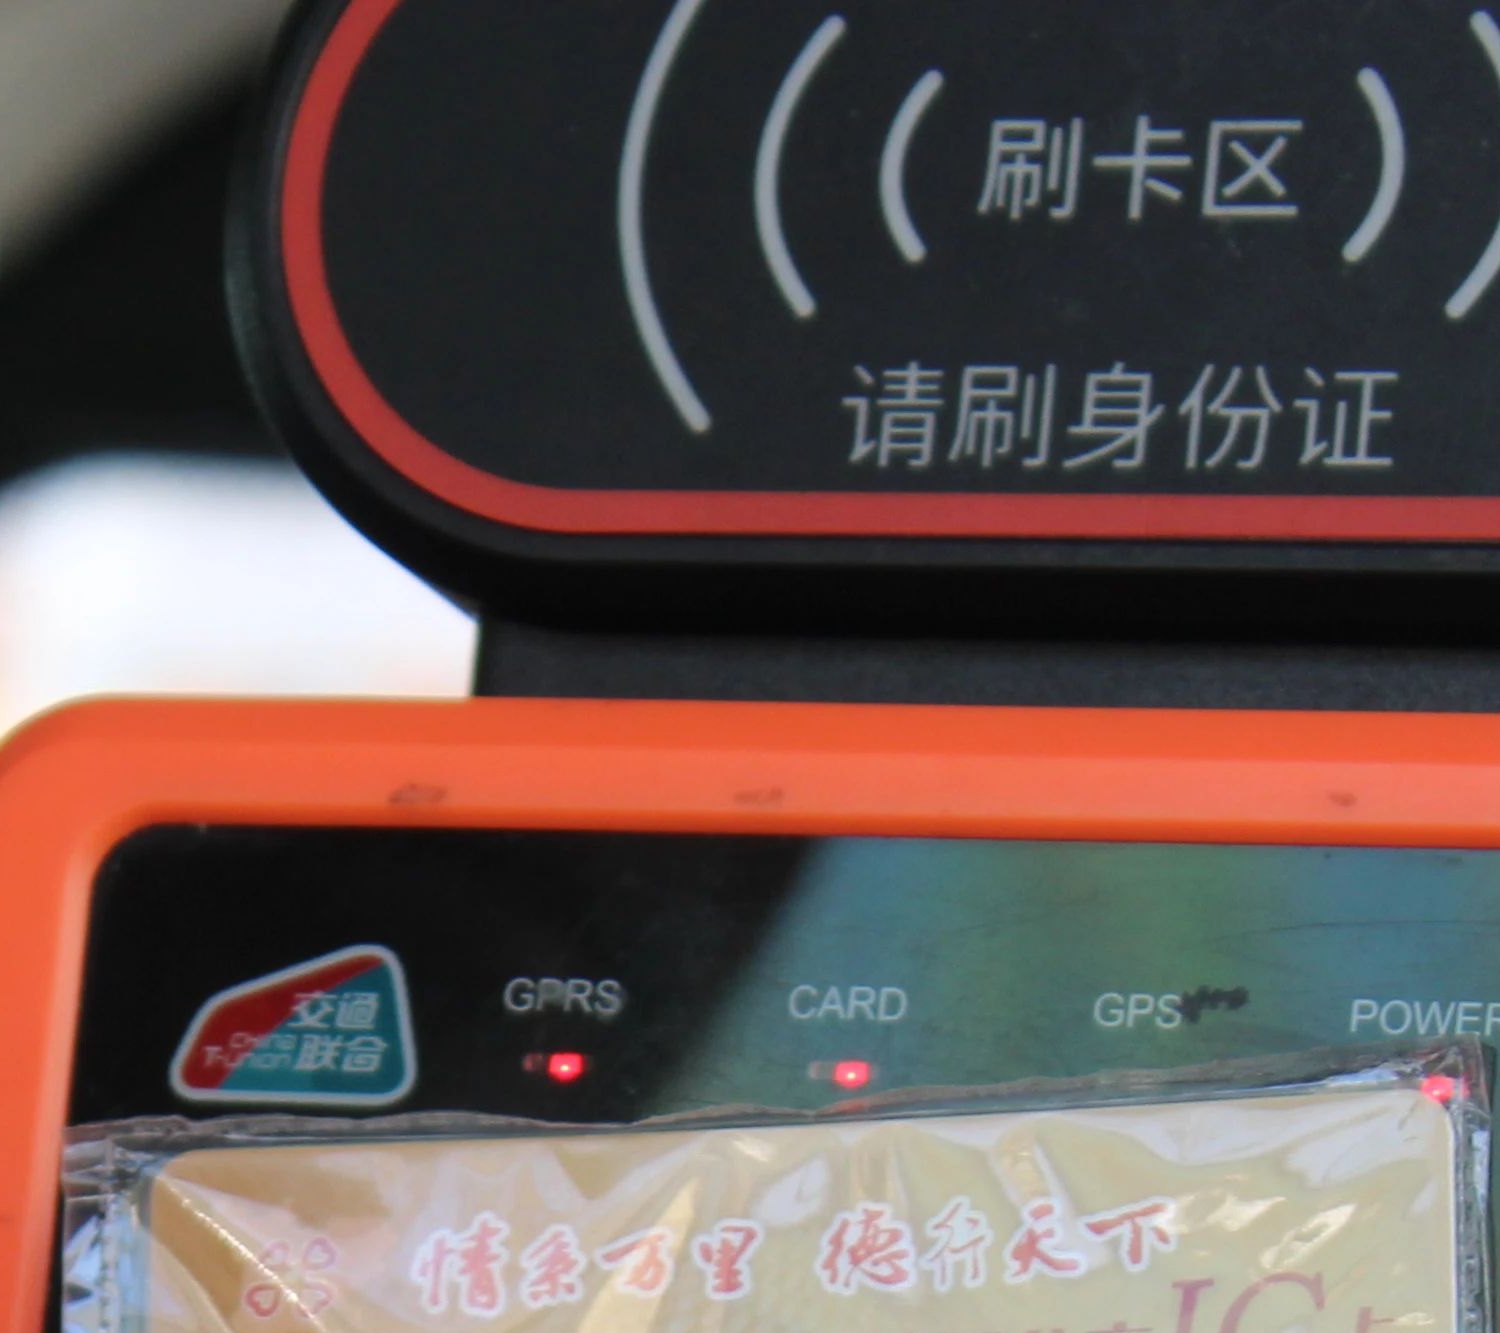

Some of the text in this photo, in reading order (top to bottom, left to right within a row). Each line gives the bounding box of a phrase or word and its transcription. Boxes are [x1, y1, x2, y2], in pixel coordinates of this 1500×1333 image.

[977, 115, 1303, 220] 刷卡区
[841, 361, 1399, 468] 请刷身份证
[287, 990, 379, 1029] 交通
[503, 976, 625, 1017] GPRS
[788, 984, 907, 1022] CARD
[1093, 991, 1184, 1030] GPS
[294, 1033, 389, 1073] 联合
